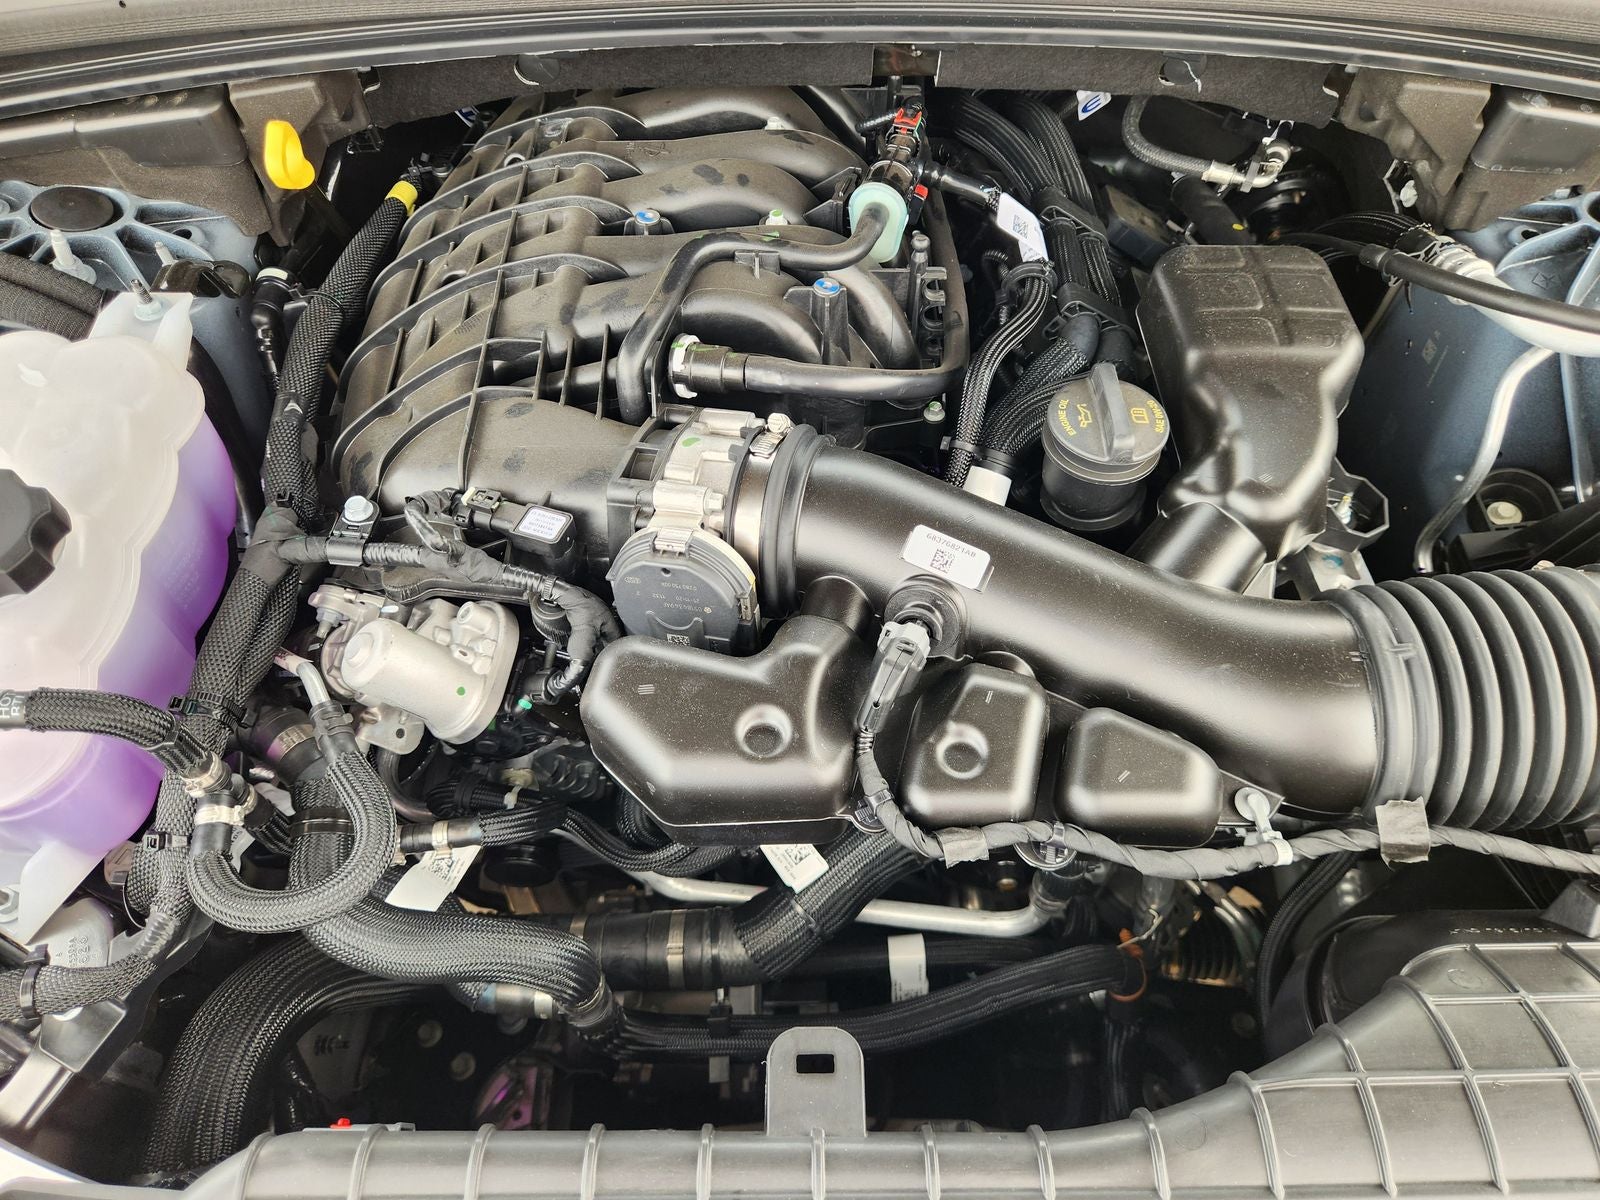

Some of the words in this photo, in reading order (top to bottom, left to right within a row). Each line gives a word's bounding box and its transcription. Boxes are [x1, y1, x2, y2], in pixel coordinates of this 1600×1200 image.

[1058, 399, 1069, 410] OIL
[1058, 409, 1077, 436] ENGINE
[1154, 418, 1165, 433] SAE
